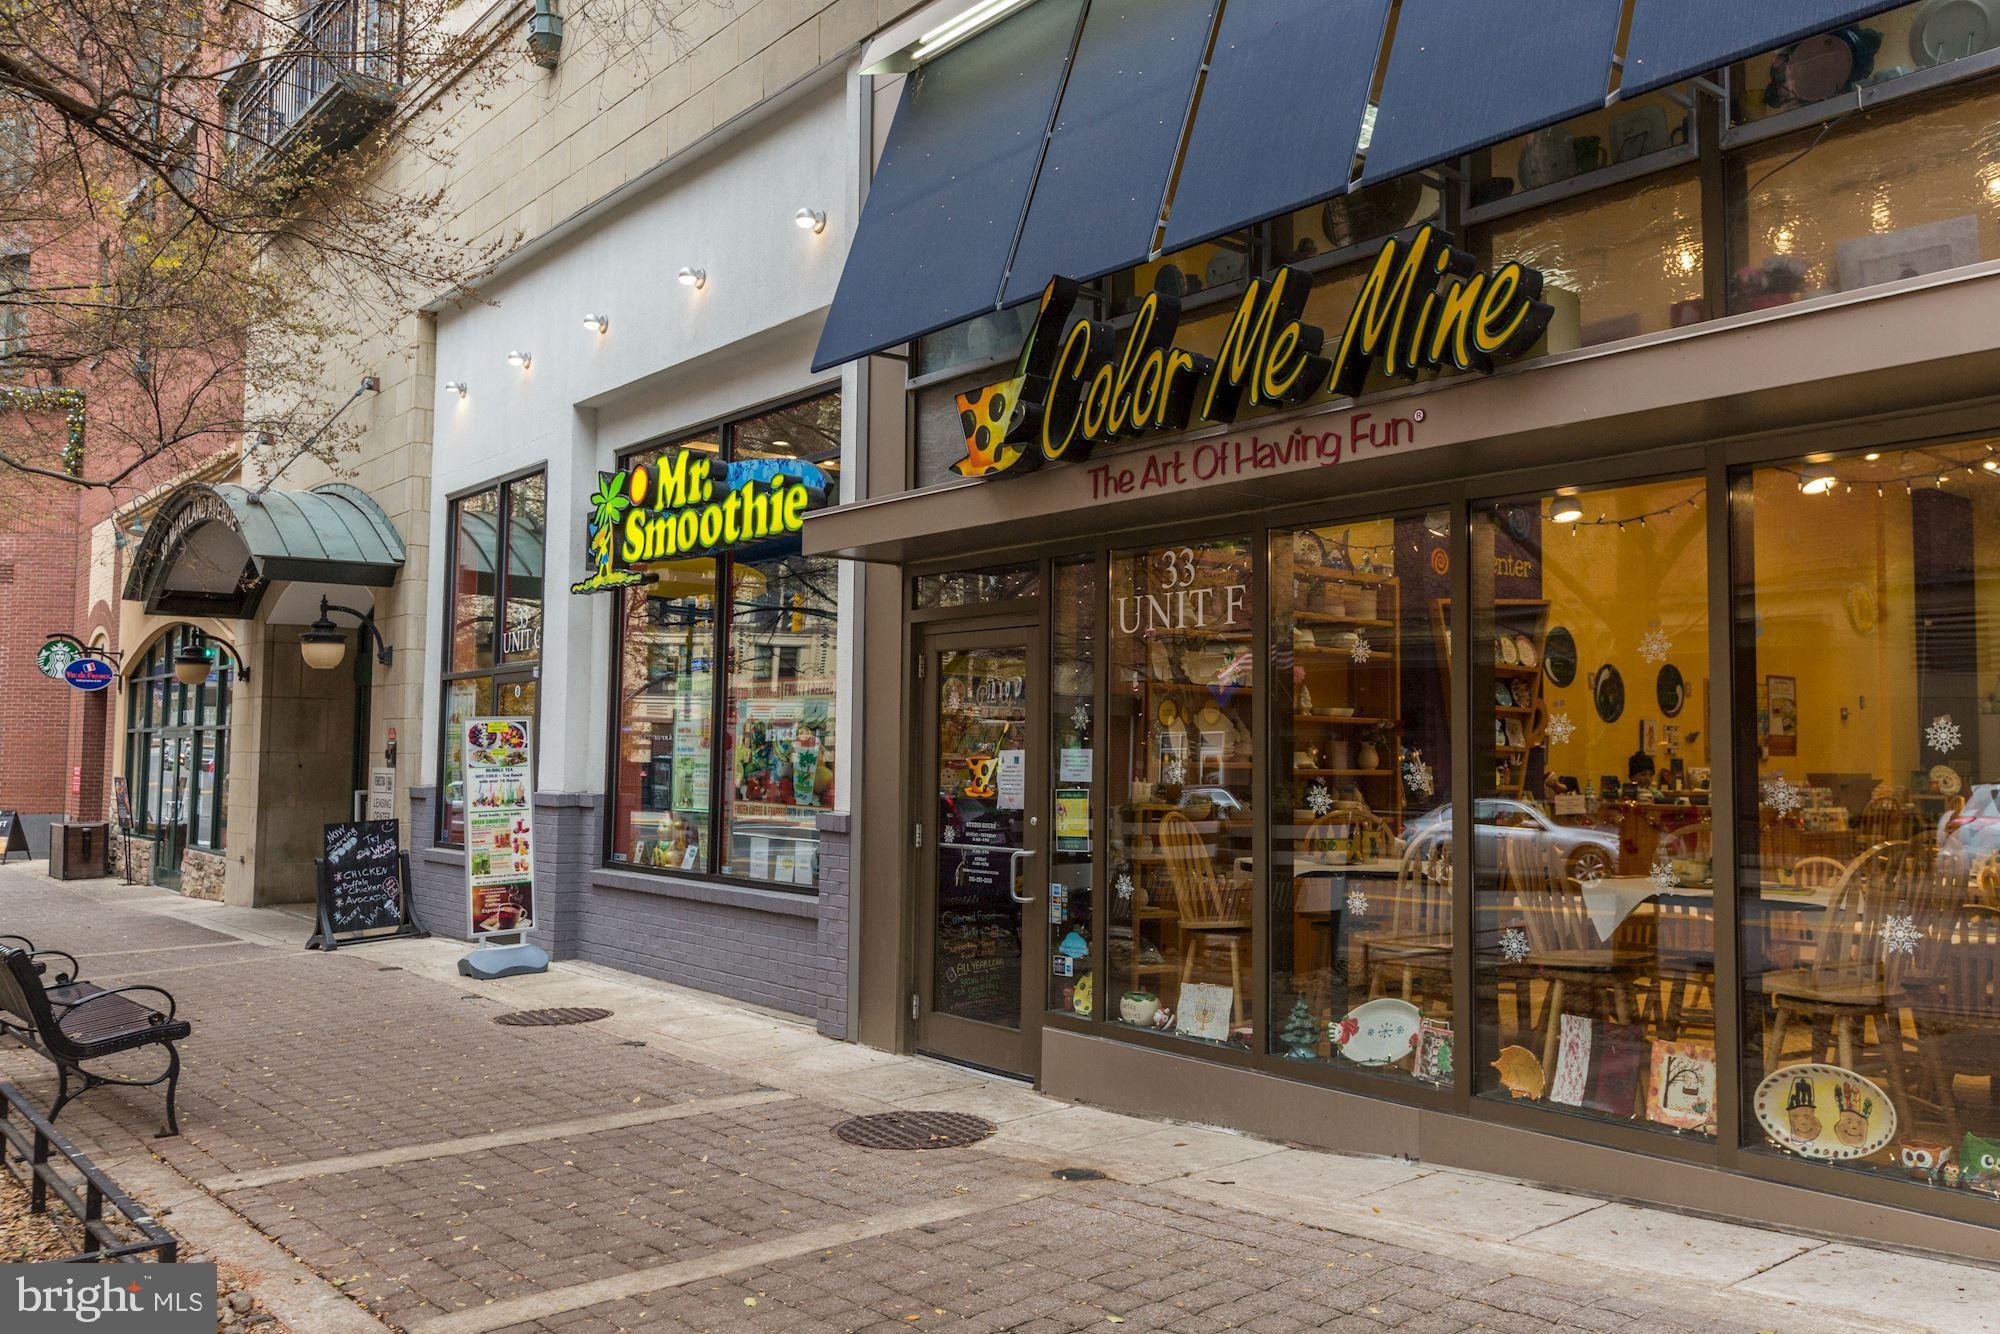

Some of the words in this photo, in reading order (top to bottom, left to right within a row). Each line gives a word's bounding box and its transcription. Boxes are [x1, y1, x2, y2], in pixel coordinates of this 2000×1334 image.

[1042, 290, 1194, 461] Color
[1200, 264, 1310, 421] Me
[1327, 222, 1531, 394] Mine
[653, 449, 714, 513] Mr.
[1087, 465, 1135, 500] The
[1139, 451, 1187, 491] Art
[1193, 442, 1228, 480] Of
[1235, 426, 1342, 468] Having
[622, 473, 809, 563] Smoothie
[1161, 547, 1196, 589] 33
[1117, 587, 1213, 635] UNIT
[1223, 584, 1247, 625] F
[503, 629, 532, 654] UNIT
[373, 798, 392, 809] LEASING
[343, 866, 389, 880] CHICKEN
[345, 893, 388, 905] AVOCADO
